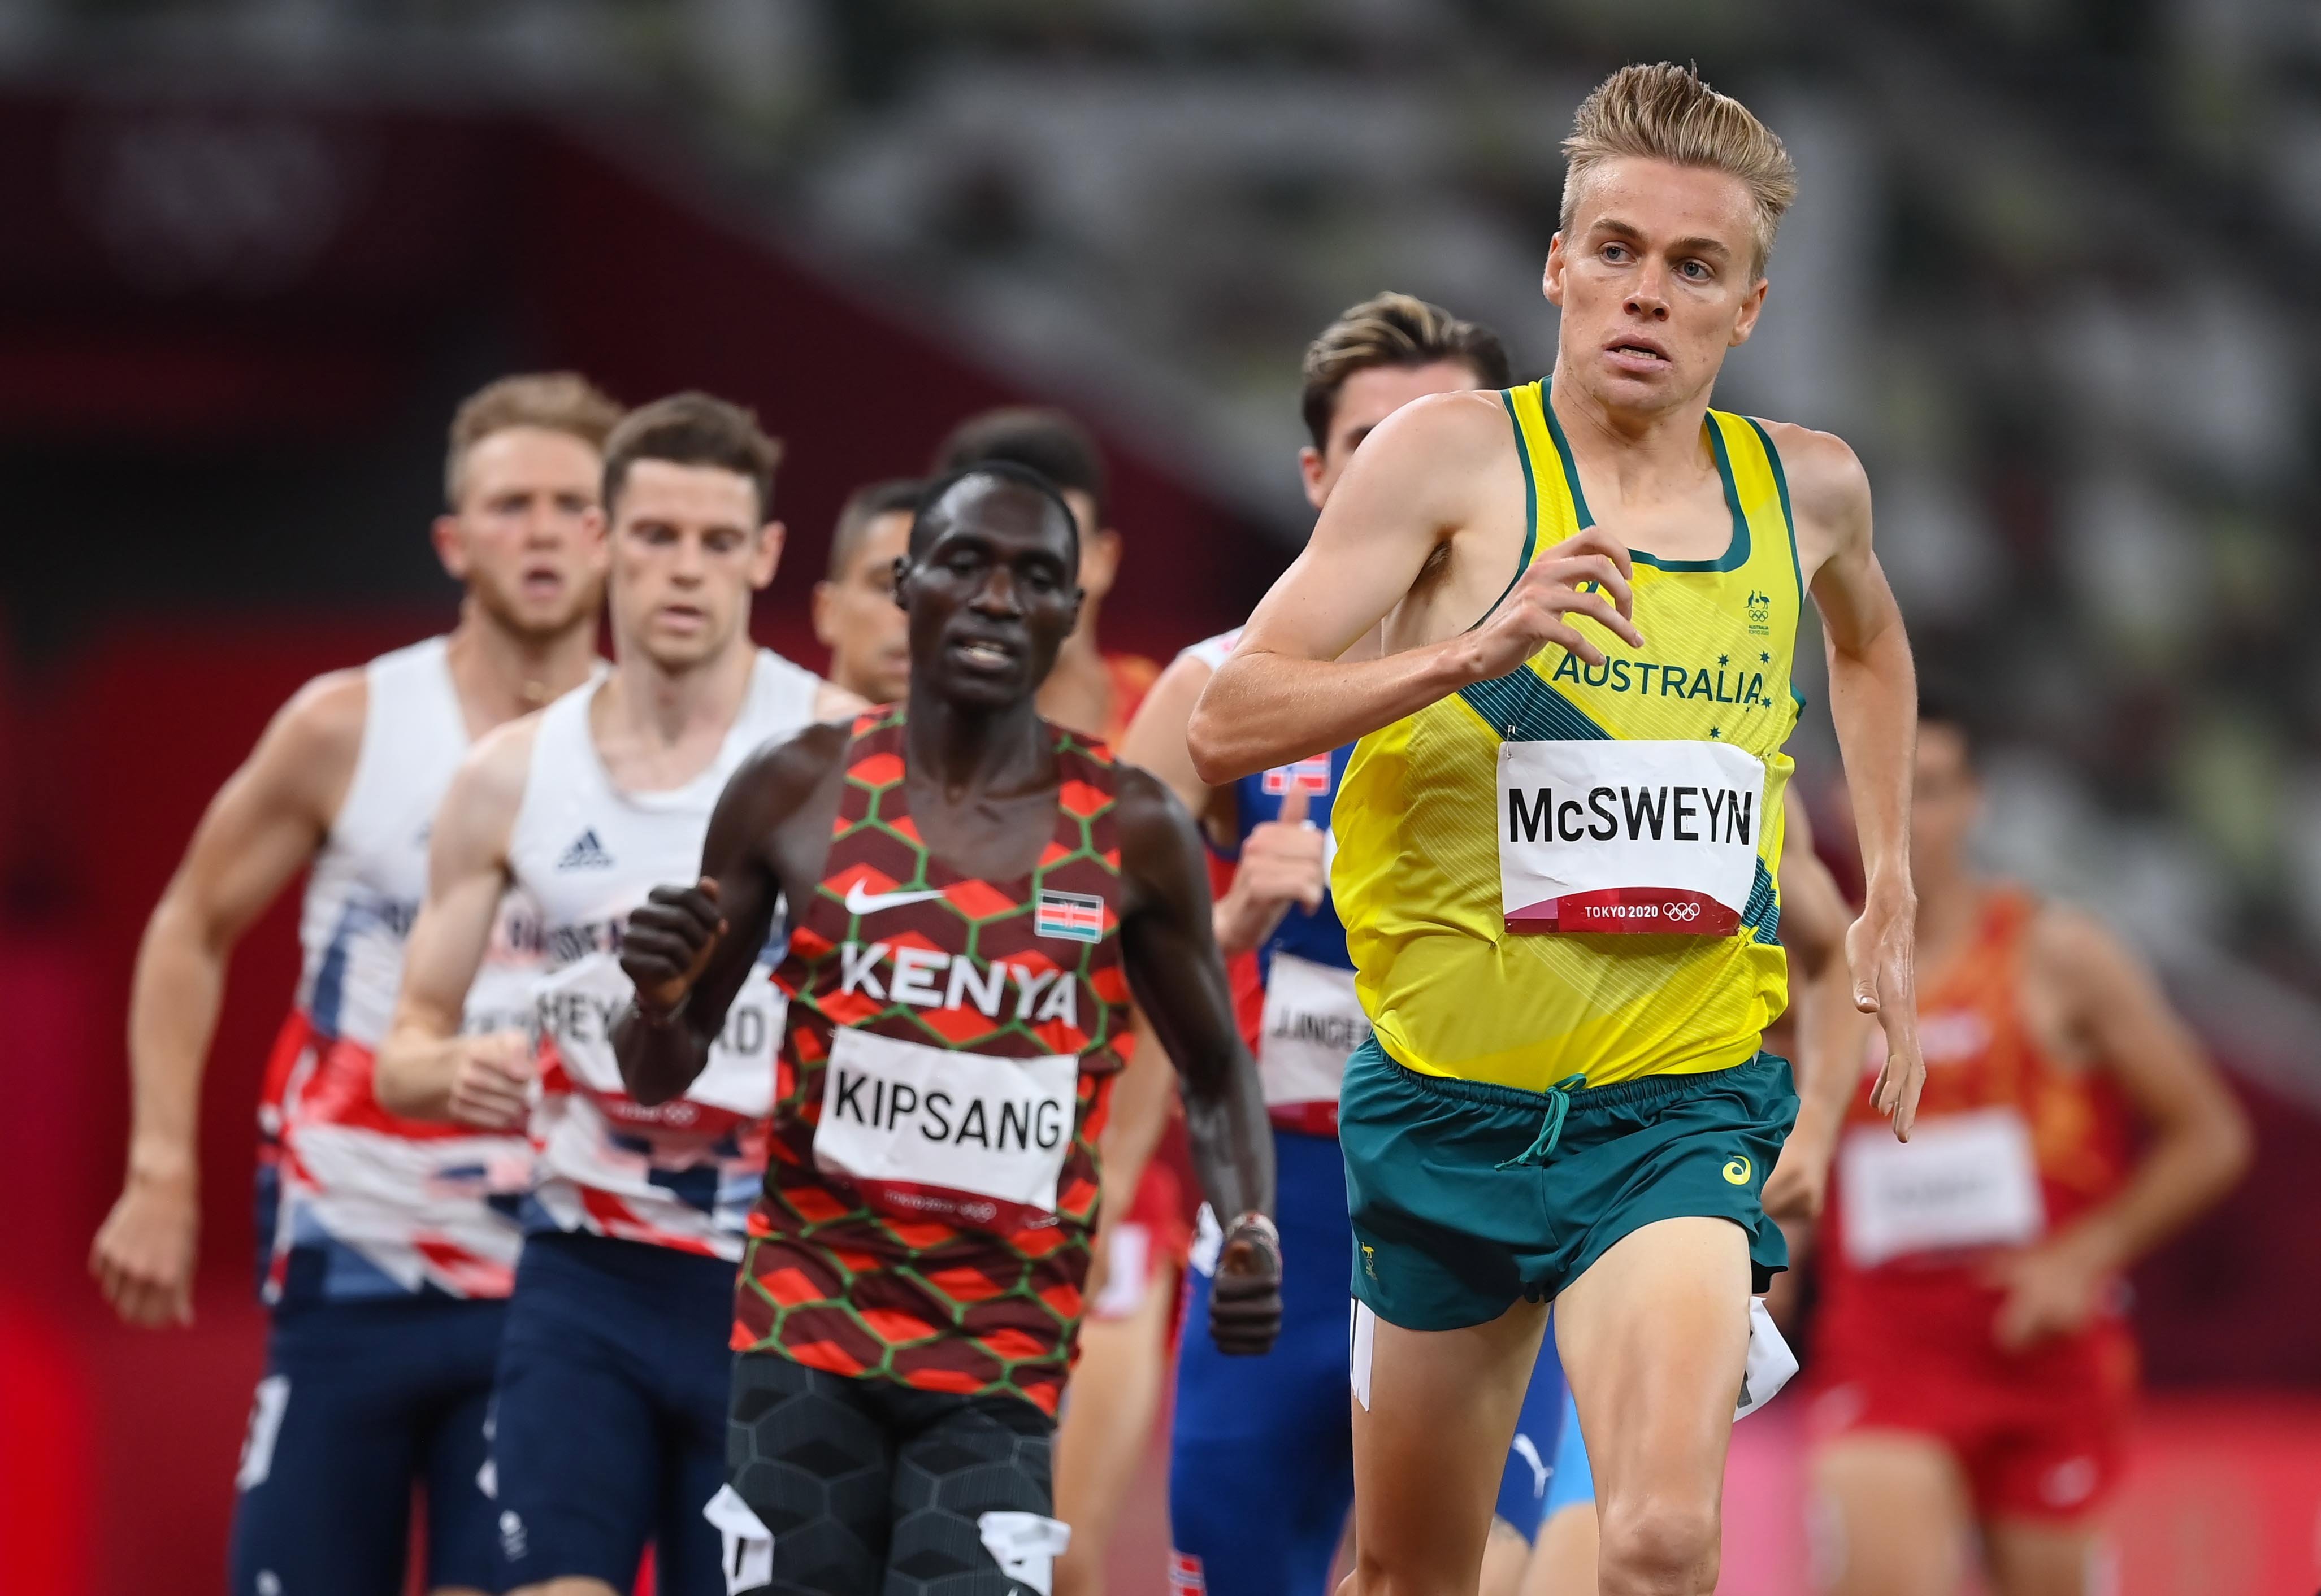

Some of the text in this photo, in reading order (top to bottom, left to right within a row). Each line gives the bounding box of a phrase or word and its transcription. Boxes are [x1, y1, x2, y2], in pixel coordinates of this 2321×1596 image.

[1552, 652, 1762, 705] AUSTRALIA
[1509, 786, 1752, 845] McSWEYN
[1585, 906, 1658, 918] TOKYO 2020
[840, 942, 1078, 1028] KENYA
[834, 1070, 1061, 1151] KIPSANG
